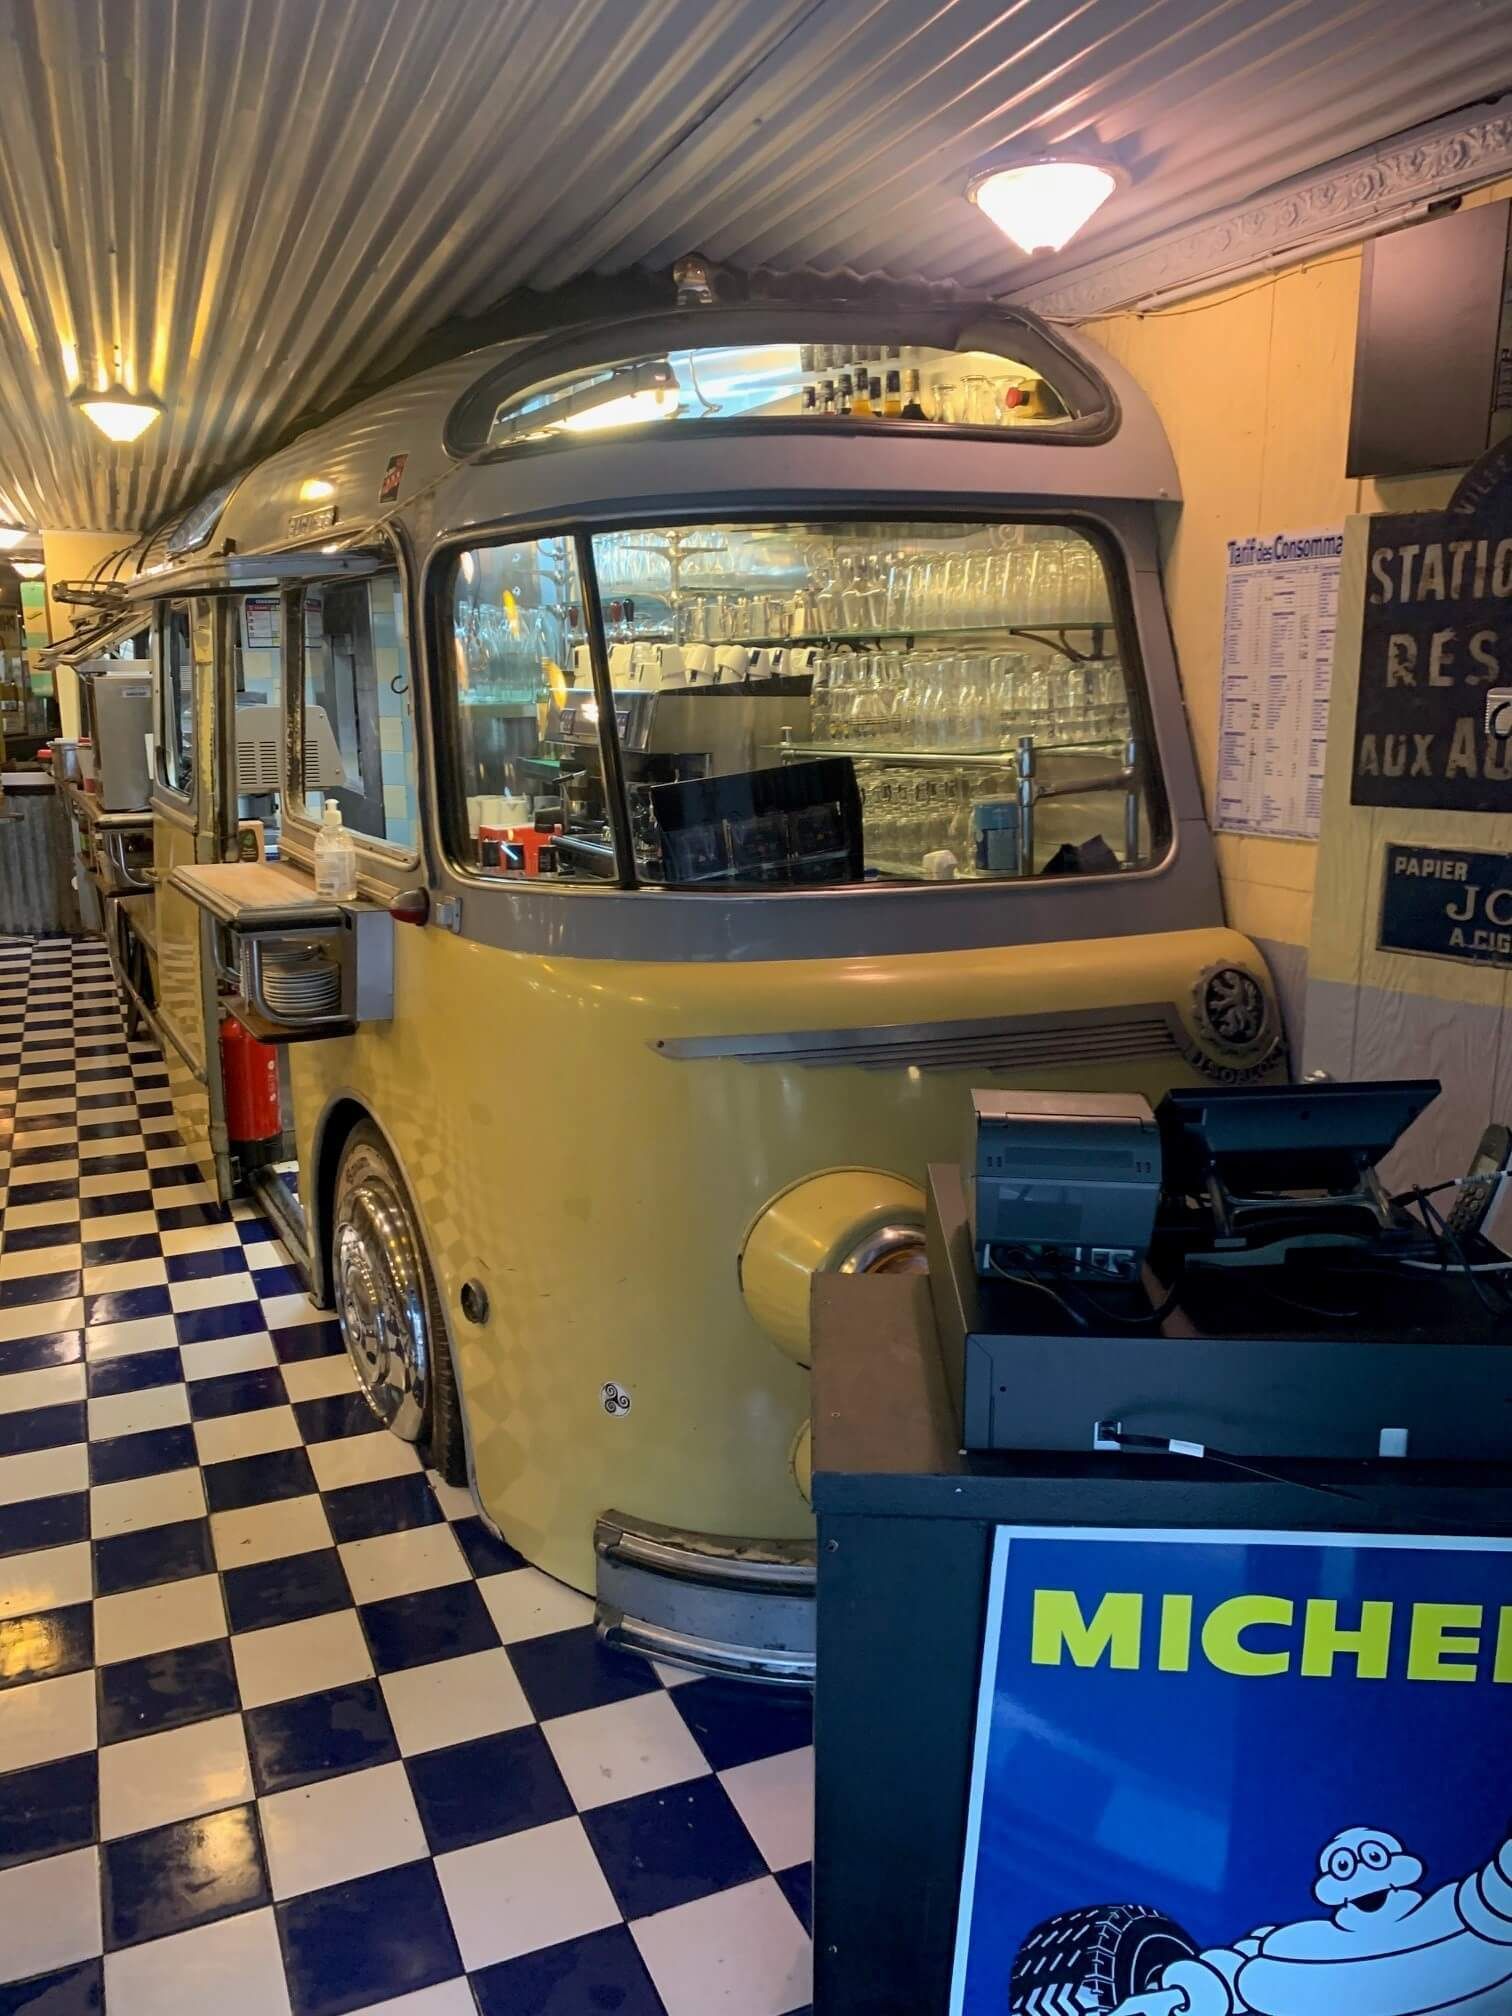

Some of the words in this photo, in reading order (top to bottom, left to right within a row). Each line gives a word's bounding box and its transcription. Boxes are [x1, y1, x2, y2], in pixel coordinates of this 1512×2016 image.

[1227, 538, 1256, 565] Tarif
[1257, 542, 1272, 561] des
[1369, 538, 1512, 605] STATIO
[1358, 734, 1435, 778] AUX
[1394, 856, 1468, 881] PAPIER
